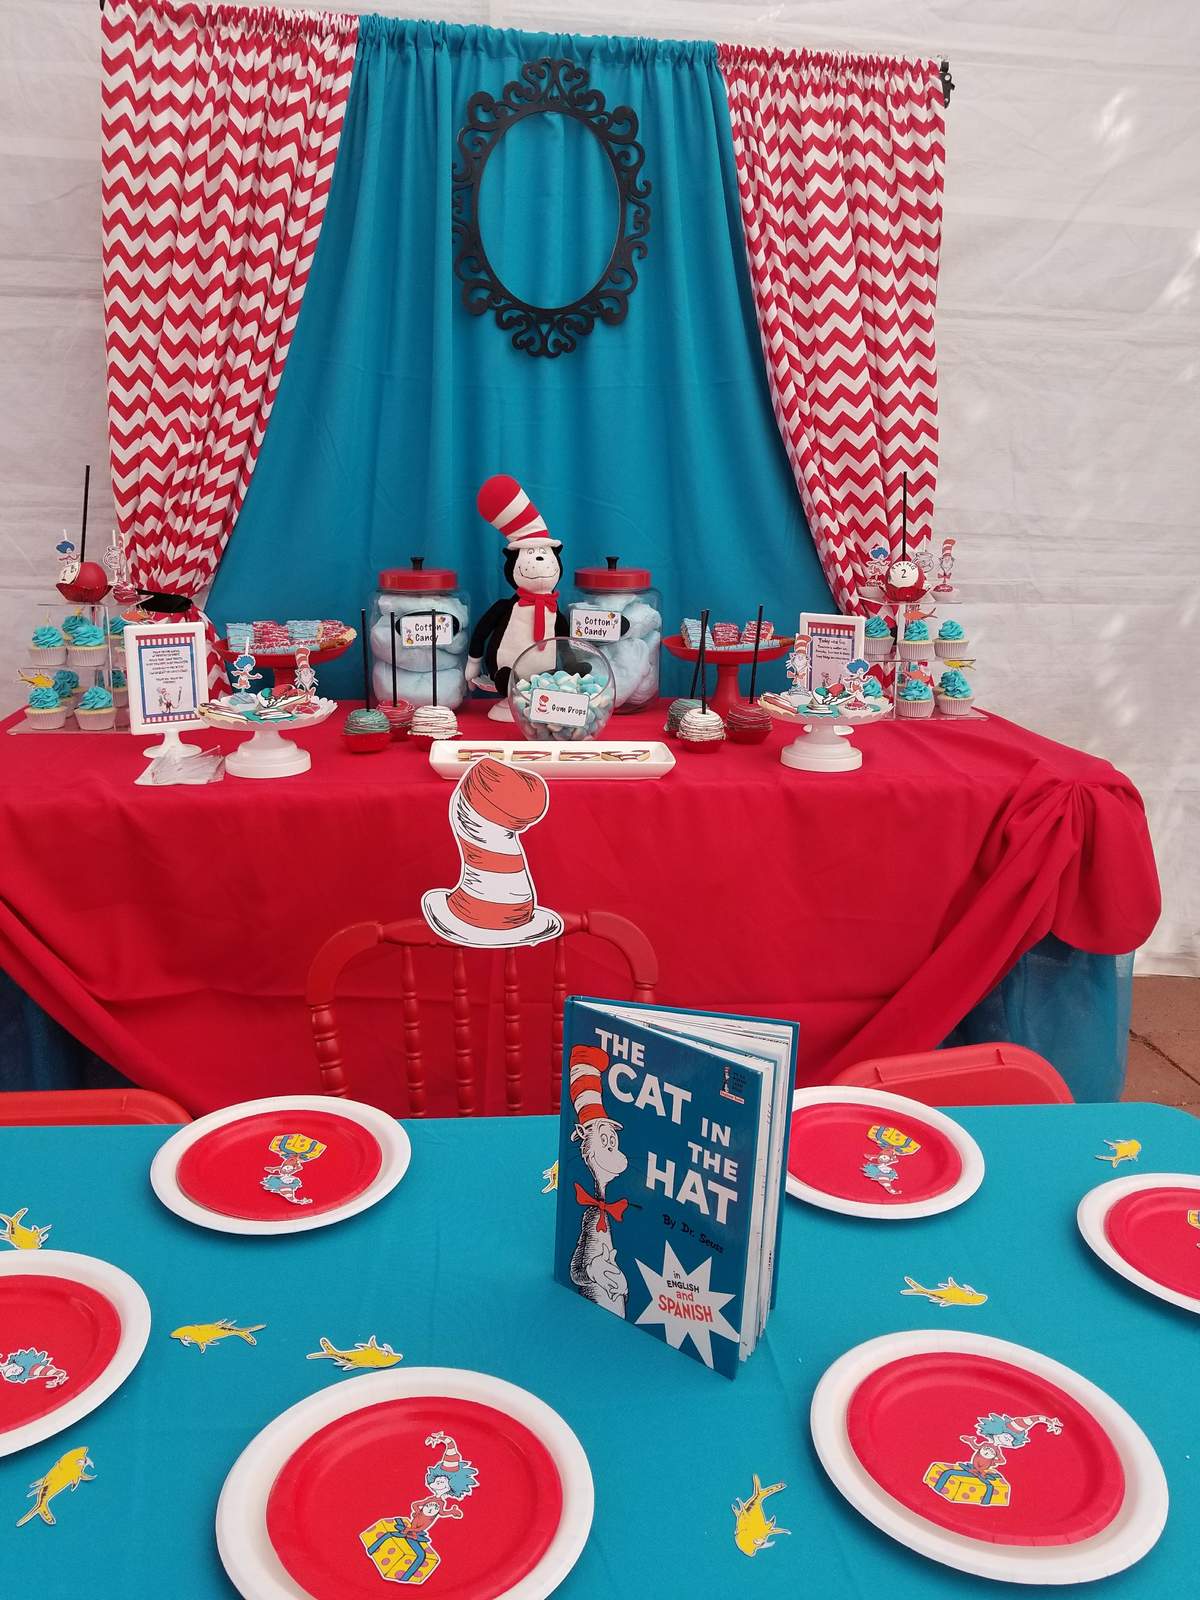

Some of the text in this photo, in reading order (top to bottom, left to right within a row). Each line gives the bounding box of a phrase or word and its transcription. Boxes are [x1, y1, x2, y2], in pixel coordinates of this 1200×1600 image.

[901, 568, 907, 579] 2
[414, 623, 442, 632] Cottn
[584, 616, 610, 626] Cotton
[584, 626, 607, 637] Candy
[551, 704, 586, 716] Gum Drops
[594, 1027, 646, 1068] THE
[608, 1062, 692, 1125] CAT
[701, 1116, 731, 1147] IN
[687, 1140, 738, 1182] THE
[646, 1151, 738, 1224] HAT
[662, 1213, 676, 1229] By
[681, 1221, 695, 1238] Dr.
[673, 1270, 681, 1280] in
[666, 1280, 700, 1293] ENGLISH
[676, 1291, 694, 1302] and
[658, 1294, 713, 1322] SPANISH
